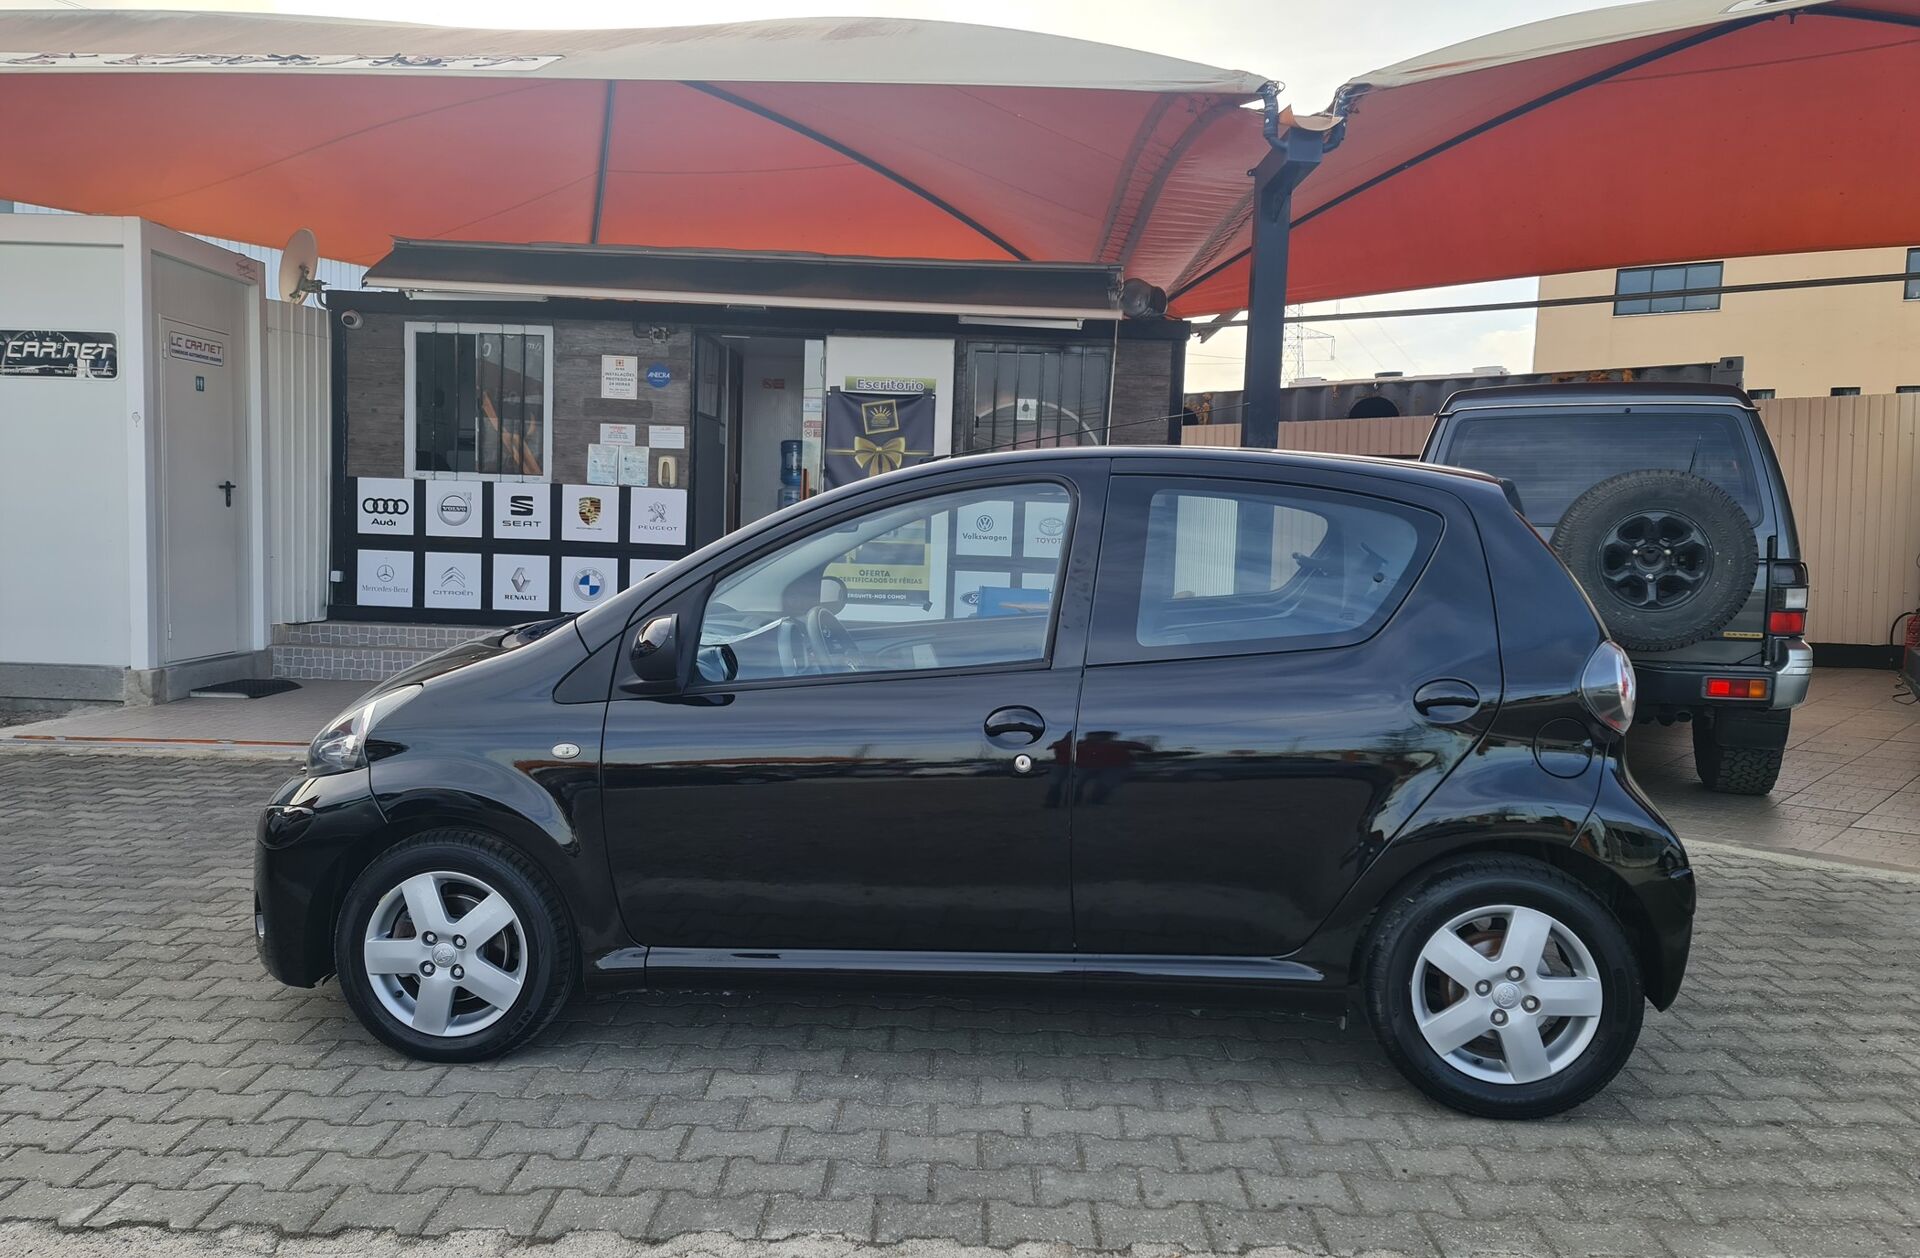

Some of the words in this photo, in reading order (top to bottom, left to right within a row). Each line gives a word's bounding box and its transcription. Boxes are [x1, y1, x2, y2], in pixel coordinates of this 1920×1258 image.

[171, 335, 183, 347] LC
[185, 339, 222, 355] CAR.NET
[7, 341, 114, 359] CAR.NET
[371, 518, 396, 526] Audi
[962, 533, 1008, 542] Volkswagen
[859, 569, 891, 577] OFERTA
[898, 577, 923, 585] FÉRIAS
[362, 584, 409, 593] Mercedes-Benz
